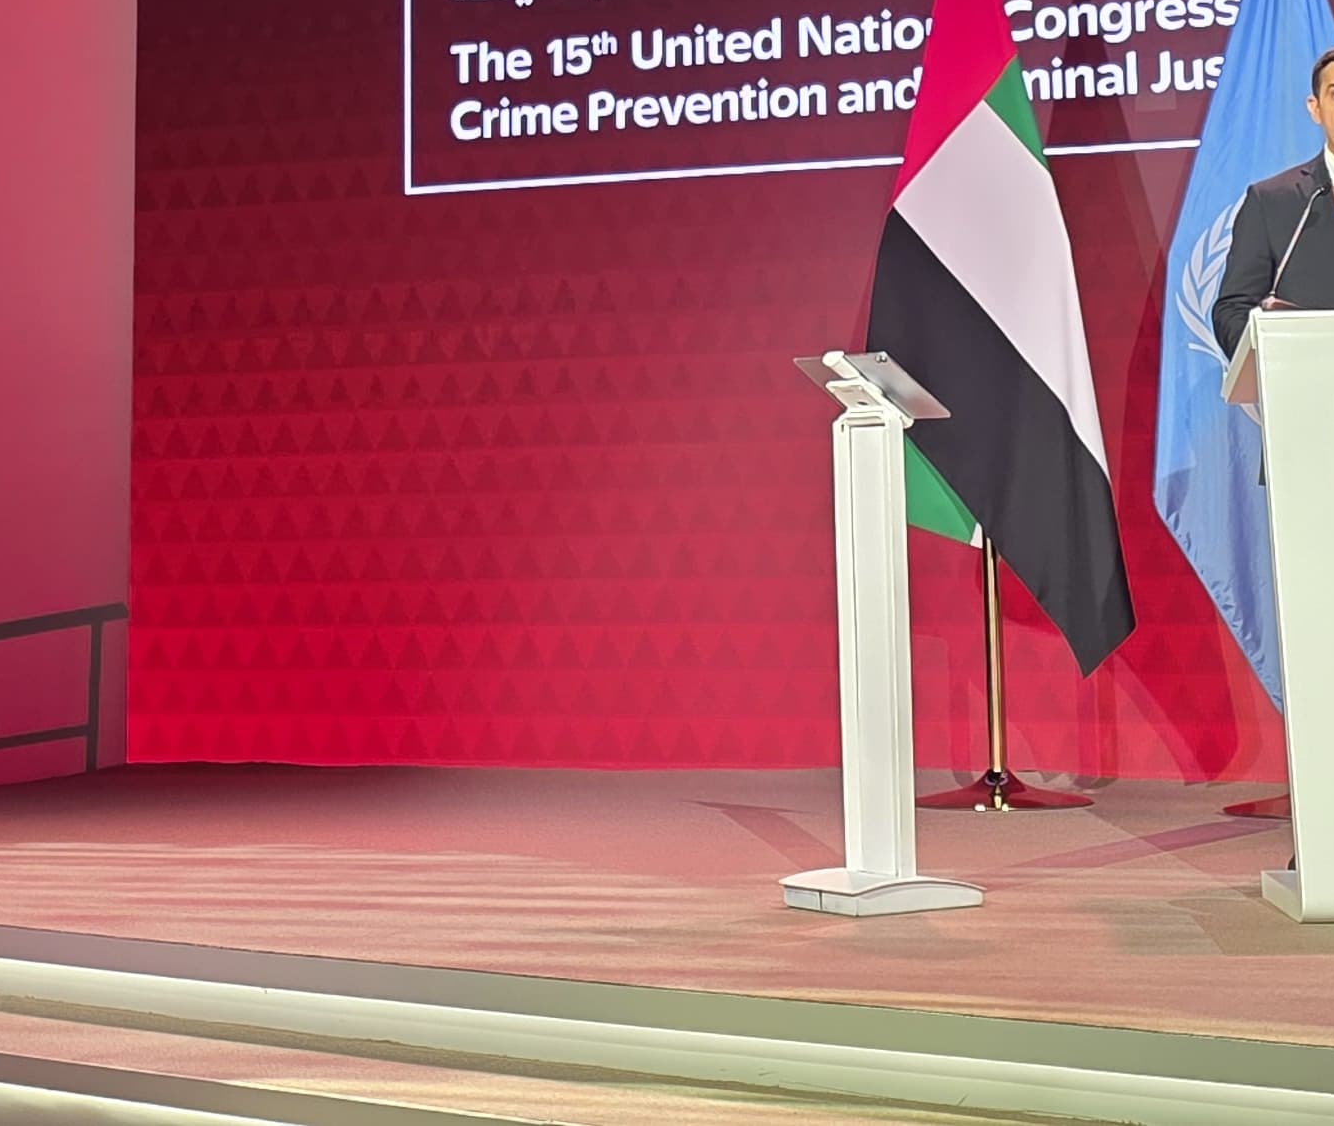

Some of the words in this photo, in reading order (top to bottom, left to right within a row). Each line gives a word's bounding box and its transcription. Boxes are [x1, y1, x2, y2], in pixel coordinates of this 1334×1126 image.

[450, 41, 533, 84] The
[546, 31, 618, 77] 15th
[631, 23, 782, 70] United
[451, 96, 579, 140] Crime
[588, 77, 827, 131] Prevention
[837, 66, 924, 114] and
